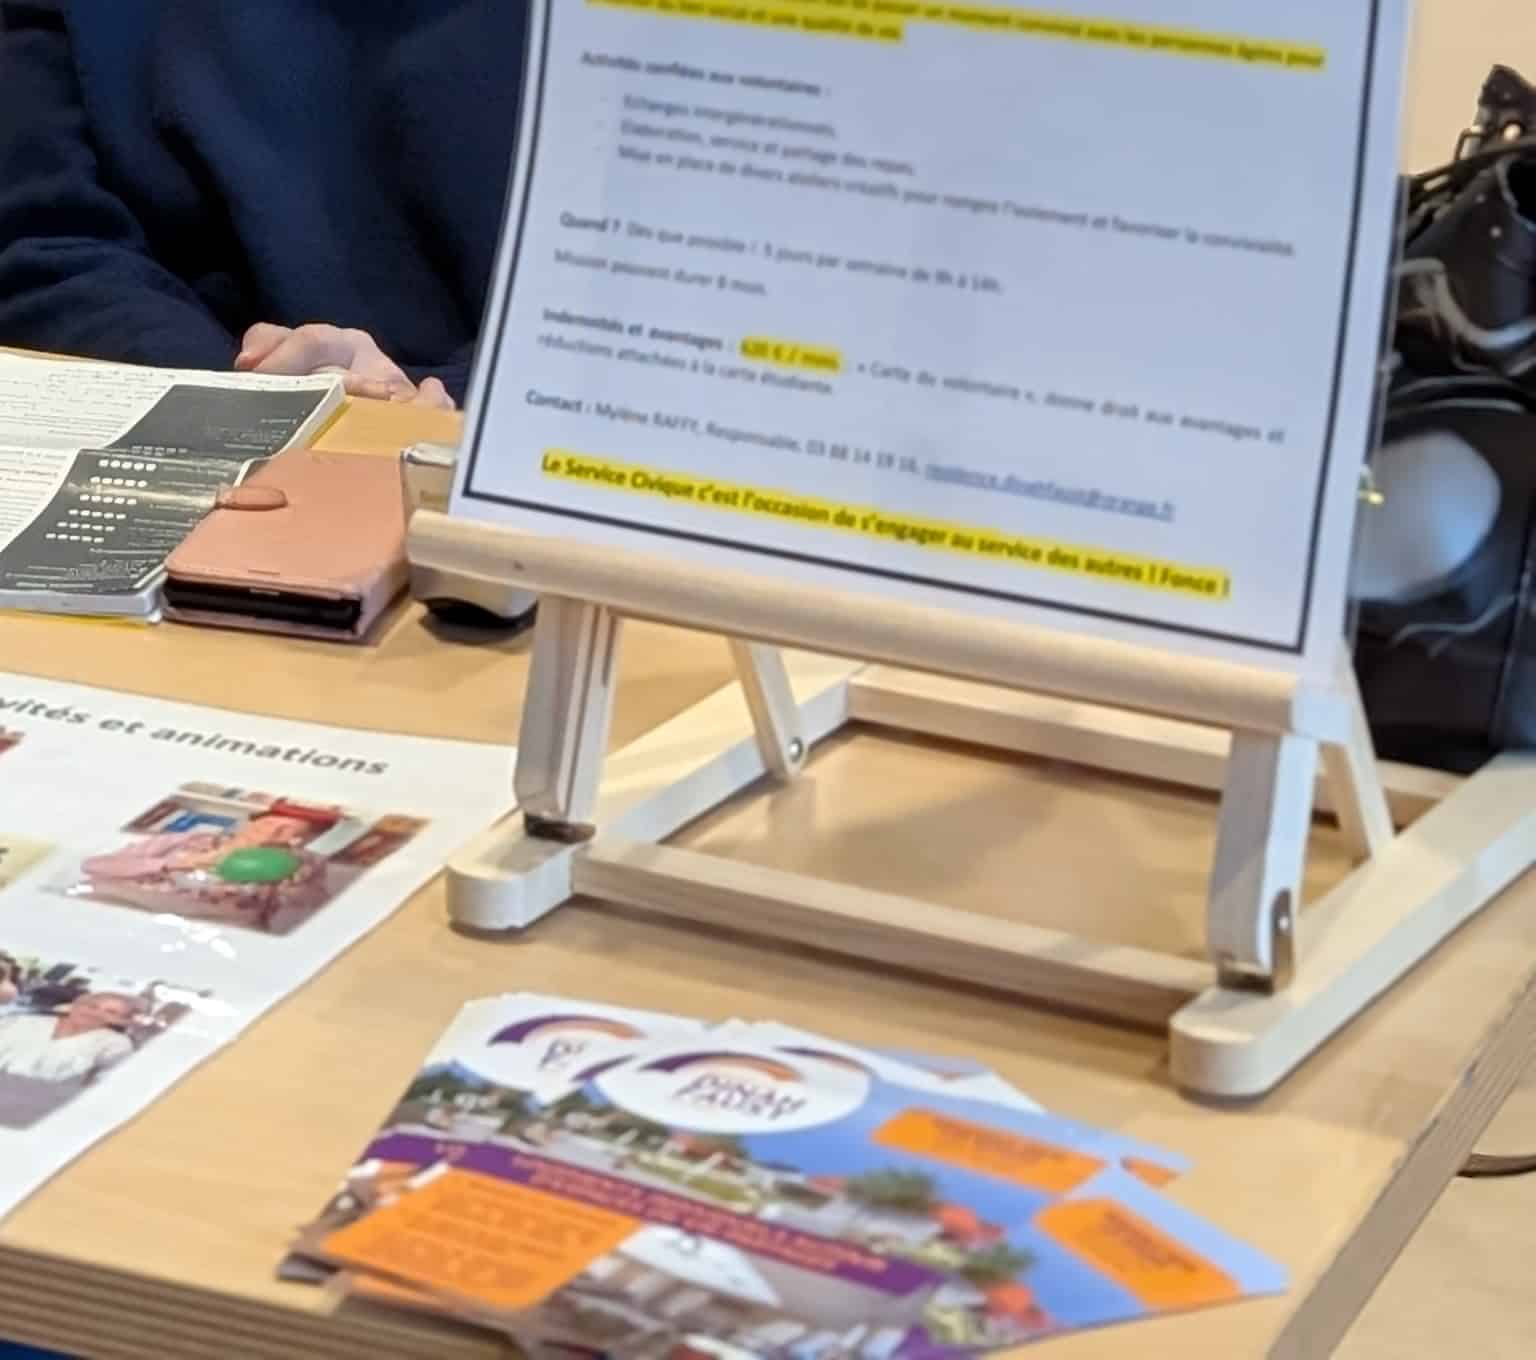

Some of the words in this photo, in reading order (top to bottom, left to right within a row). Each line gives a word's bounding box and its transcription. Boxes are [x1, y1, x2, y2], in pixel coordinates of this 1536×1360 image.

[541, 452, 562, 476] Le
[564, 458, 627, 488] Service
[630, 468, 696, 501] Civique
[698, 482, 740, 510] c'est
[742, 489, 831, 524] l'occasion
[833, 509, 859, 529] de
[861, 512, 948, 547] s'engager
[950, 531, 973, 552] au
[976, 535, 1043, 565] service
[1047, 546, 1080, 570] des
[1083, 554, 1143, 583] autres
[98, 713, 146, 736] et
[149, 726, 390, 777] animations
